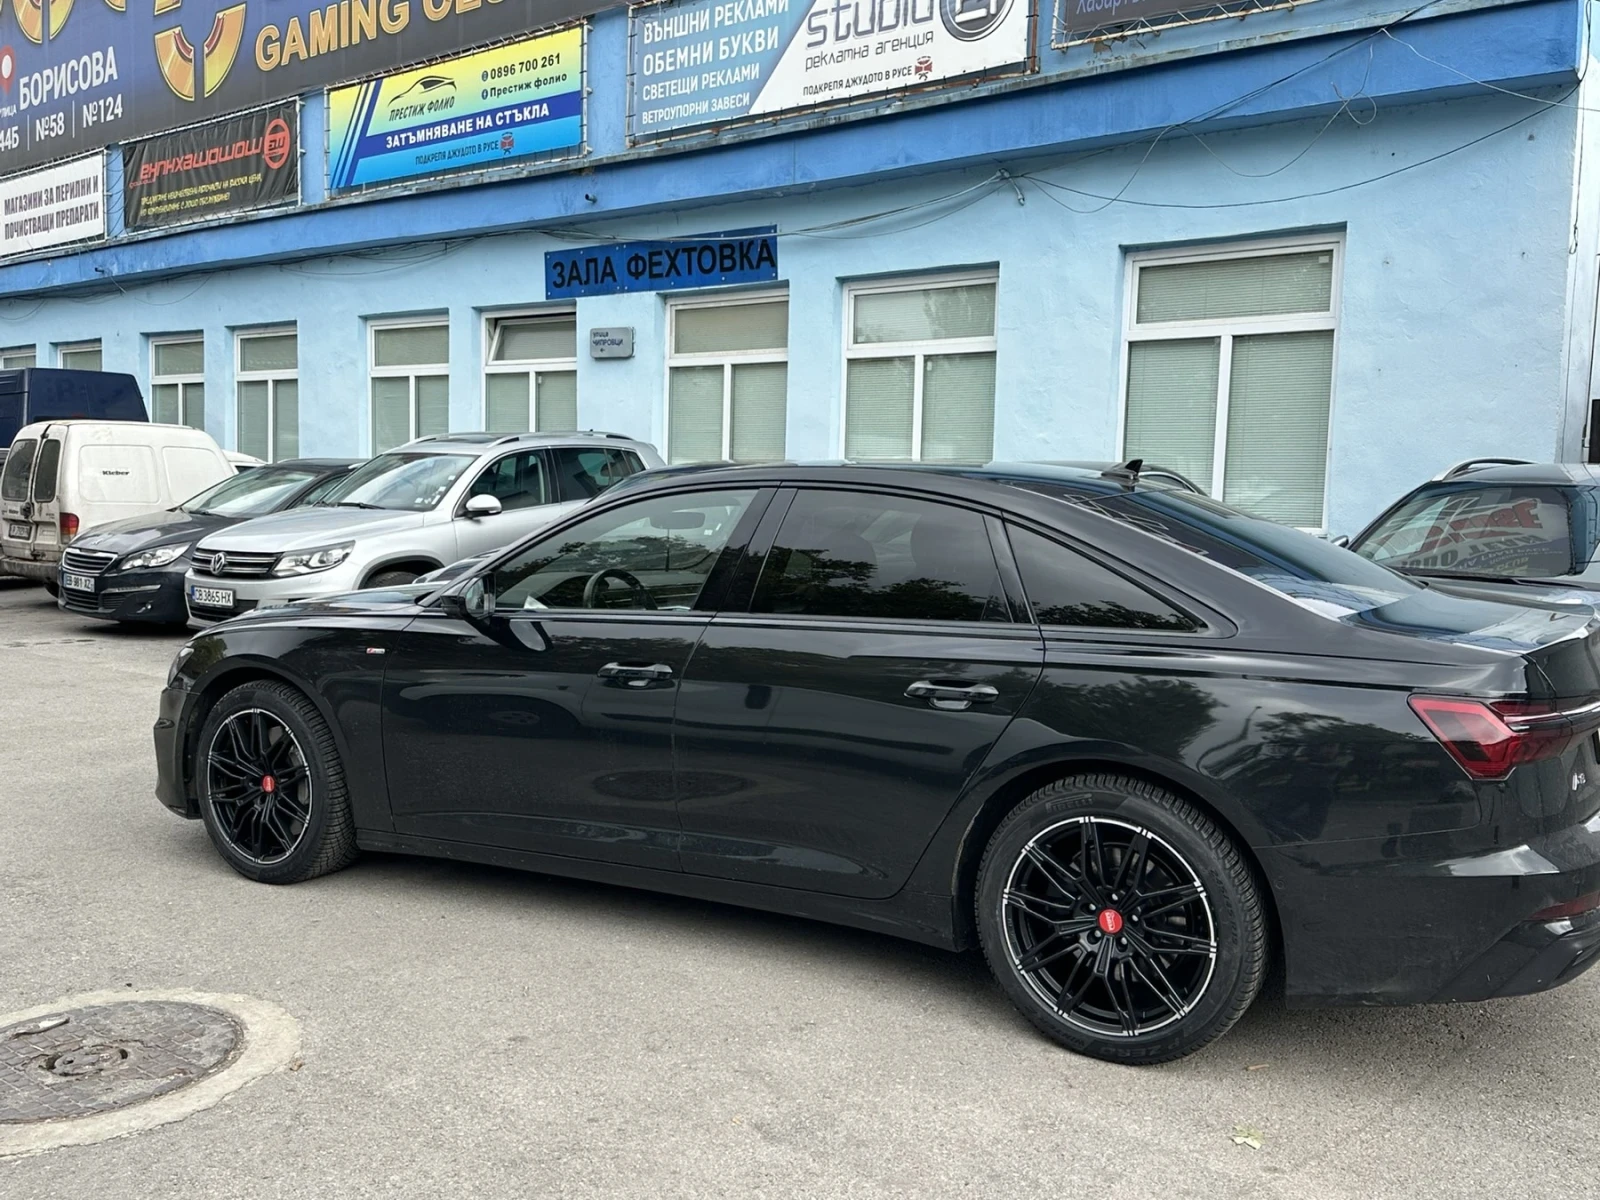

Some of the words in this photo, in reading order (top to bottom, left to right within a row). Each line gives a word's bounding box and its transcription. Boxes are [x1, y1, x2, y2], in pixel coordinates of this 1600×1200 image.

[255, 0, 410, 71] GAMING
[644, 9, 710, 44] ВЪНШНИ
[714, 0, 789, 28] РЕКЛАМИ
[643, 40, 713, 76] ОБЕМНИ
[719, 26, 779, 60] БУКВИ
[875, 31, 934, 57] агенция
[20, 46, 118, 110] БОРИСОВА
[490, 63, 516, 80] 0896
[518, 58, 538, 73] 700
[541, 52, 560, 68] 261
[643, 77, 698, 101] СВЕТЕЩИ
[702, 63, 760, 90] РЕКЛАМИ
[803, 77, 844, 96] ПОДКРЕПЯ
[845, 72, 883, 89] ДЖУДОТО
[885, 69, 890, 80] В
[892, 65, 913, 79] РУСЕ
[490, 81, 532, 99] Престиж
[534, 73, 567, 90] фолио
[36, 111, 65, 142] №58
[83, 94, 123, 128] №124
[386, 118, 473, 149] ЗАТЪМНЯВАНЕ
[476, 115, 493, 130] НА
[496, 103, 549, 125] СТЪКЛА
[388, 102, 425, 121] ПРЕСТИЖ
[427, 96, 455, 114] ФОЛИО
[642, 101, 709, 124] ВЕТРОУПОРНИ
[711, 92, 750, 112] ЗАВЕСИ
[416, 150, 446, 165] ПОДКРЕПЯ
[447, 145, 476, 161] ДЖУДОТО
[477, 144, 482, 153] В
[483, 140, 499, 152] РУСЕ
[4, 190, 43, 216] МАГАЗИНИ
[44, 187, 54, 206] ЗА
[55, 177, 91, 203] ПЕРИЛНИ
[93, 174, 98, 194] И
[4, 212, 54, 240] ПОЧИСТВАЩИ
[55, 201, 99, 228] ПРЕПАРАТИ
[552, 256, 617, 289] ЗАЛА
[627, 239, 776, 280] ФЕХТОВКА
